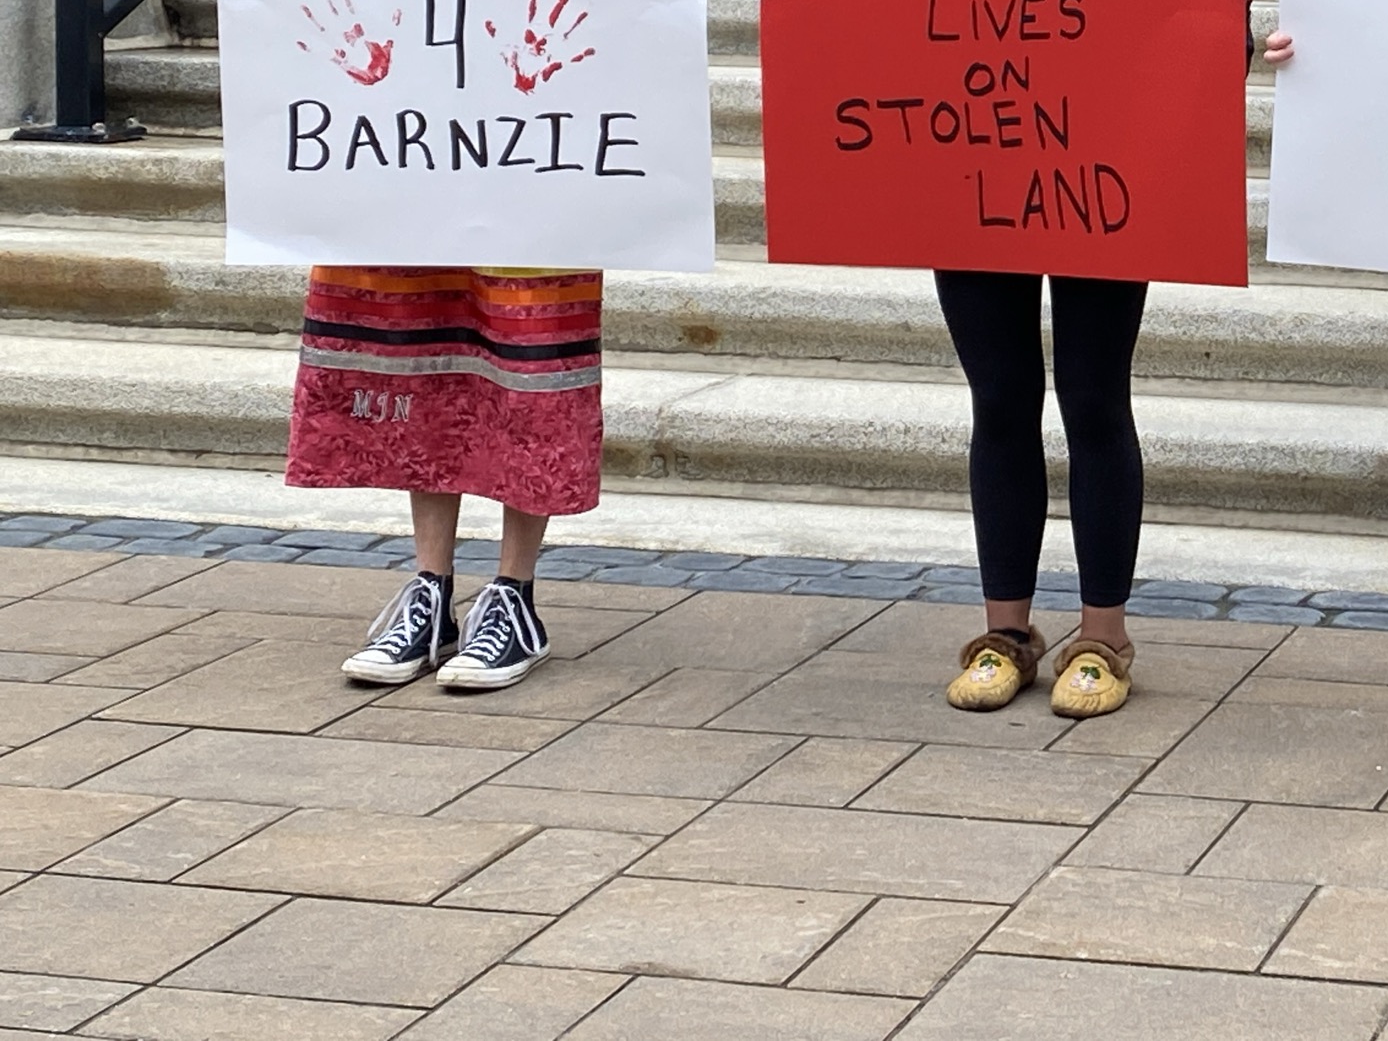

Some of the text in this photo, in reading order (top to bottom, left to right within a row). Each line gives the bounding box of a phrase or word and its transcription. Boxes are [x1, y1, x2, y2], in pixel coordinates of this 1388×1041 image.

[964, 56, 1030, 98] ON
[286, 98, 647, 177] BARNZIE
[835, 95, 1070, 151] STOLEN
[978, 162, 1131, 236] LAND
